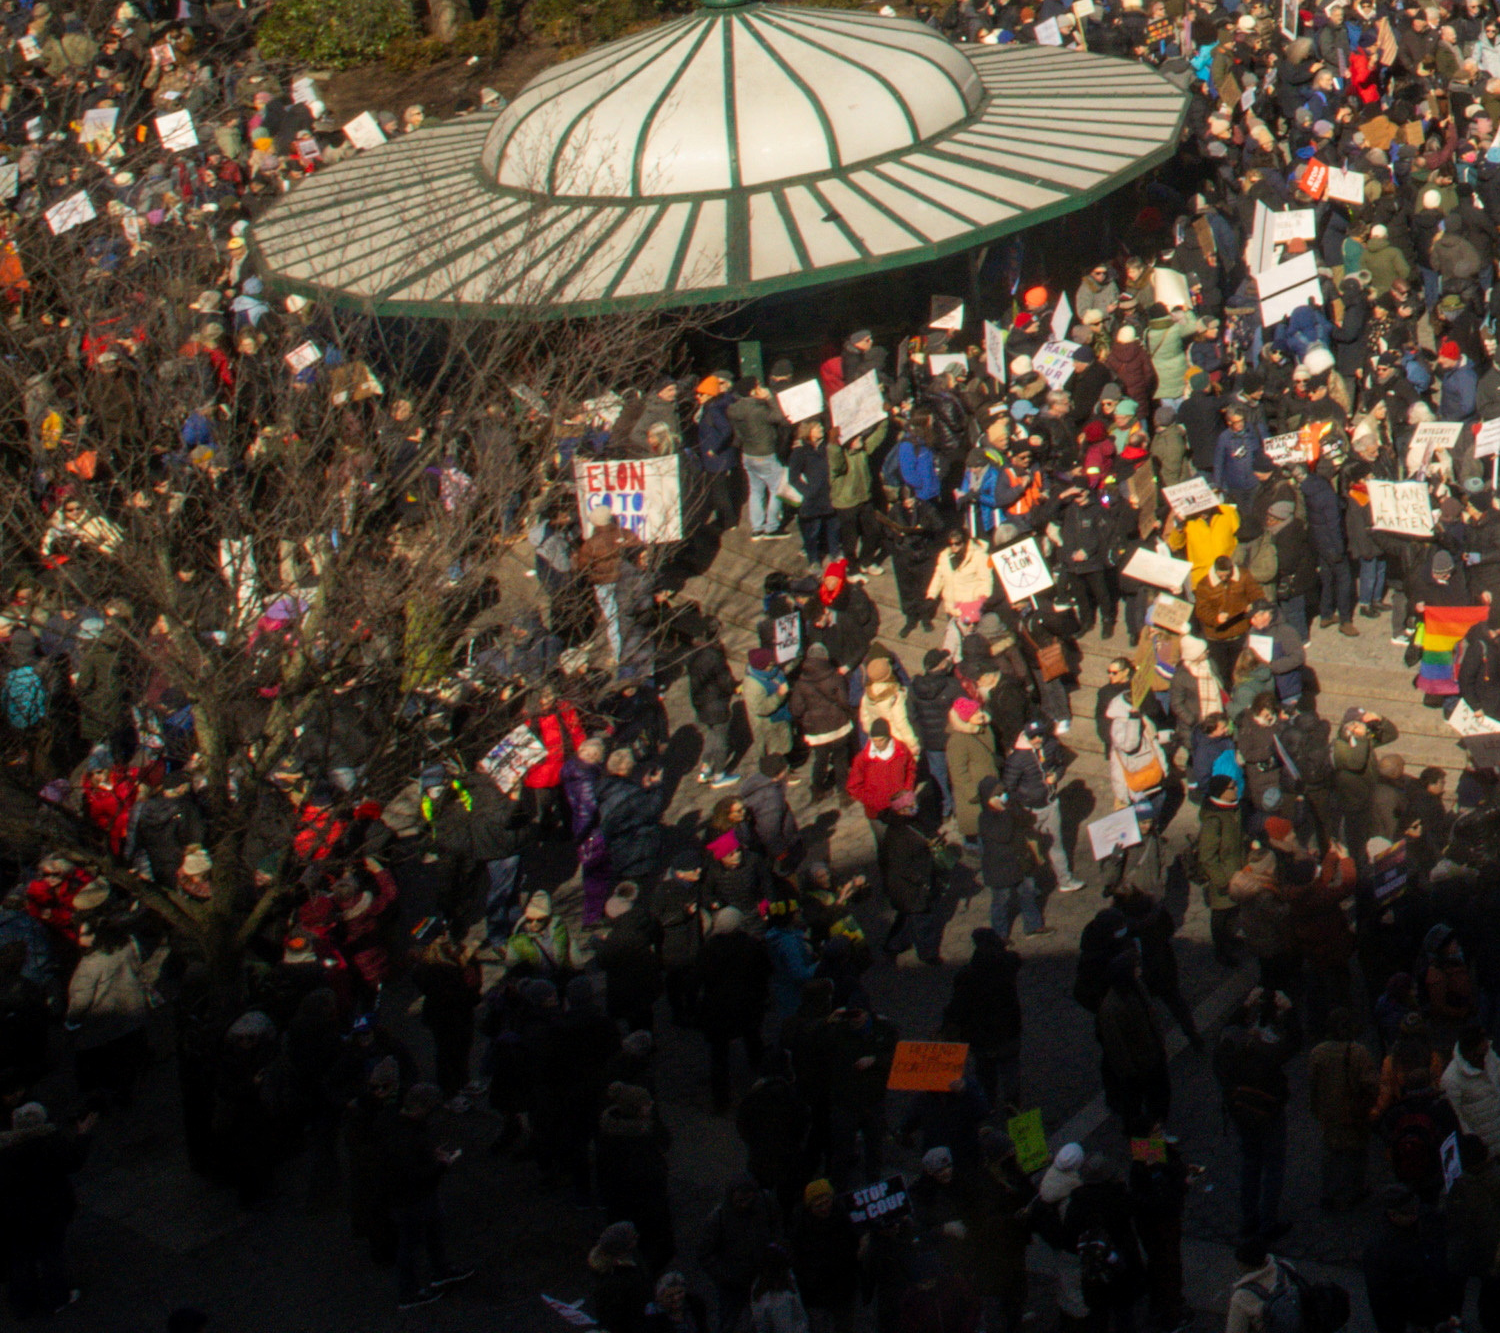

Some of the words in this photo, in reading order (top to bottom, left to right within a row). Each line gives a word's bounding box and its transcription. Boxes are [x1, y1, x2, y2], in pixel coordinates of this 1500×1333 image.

[586, 461, 647, 493] ELON
[617, 492, 644, 513] TO
[1377, 484, 1425, 502] TRANS
[1376, 515, 1432, 529] MATTER
[1007, 557, 1034, 574] ELON
[853, 1181, 889, 1207] STOP
[867, 1190, 907, 1220] COUP
